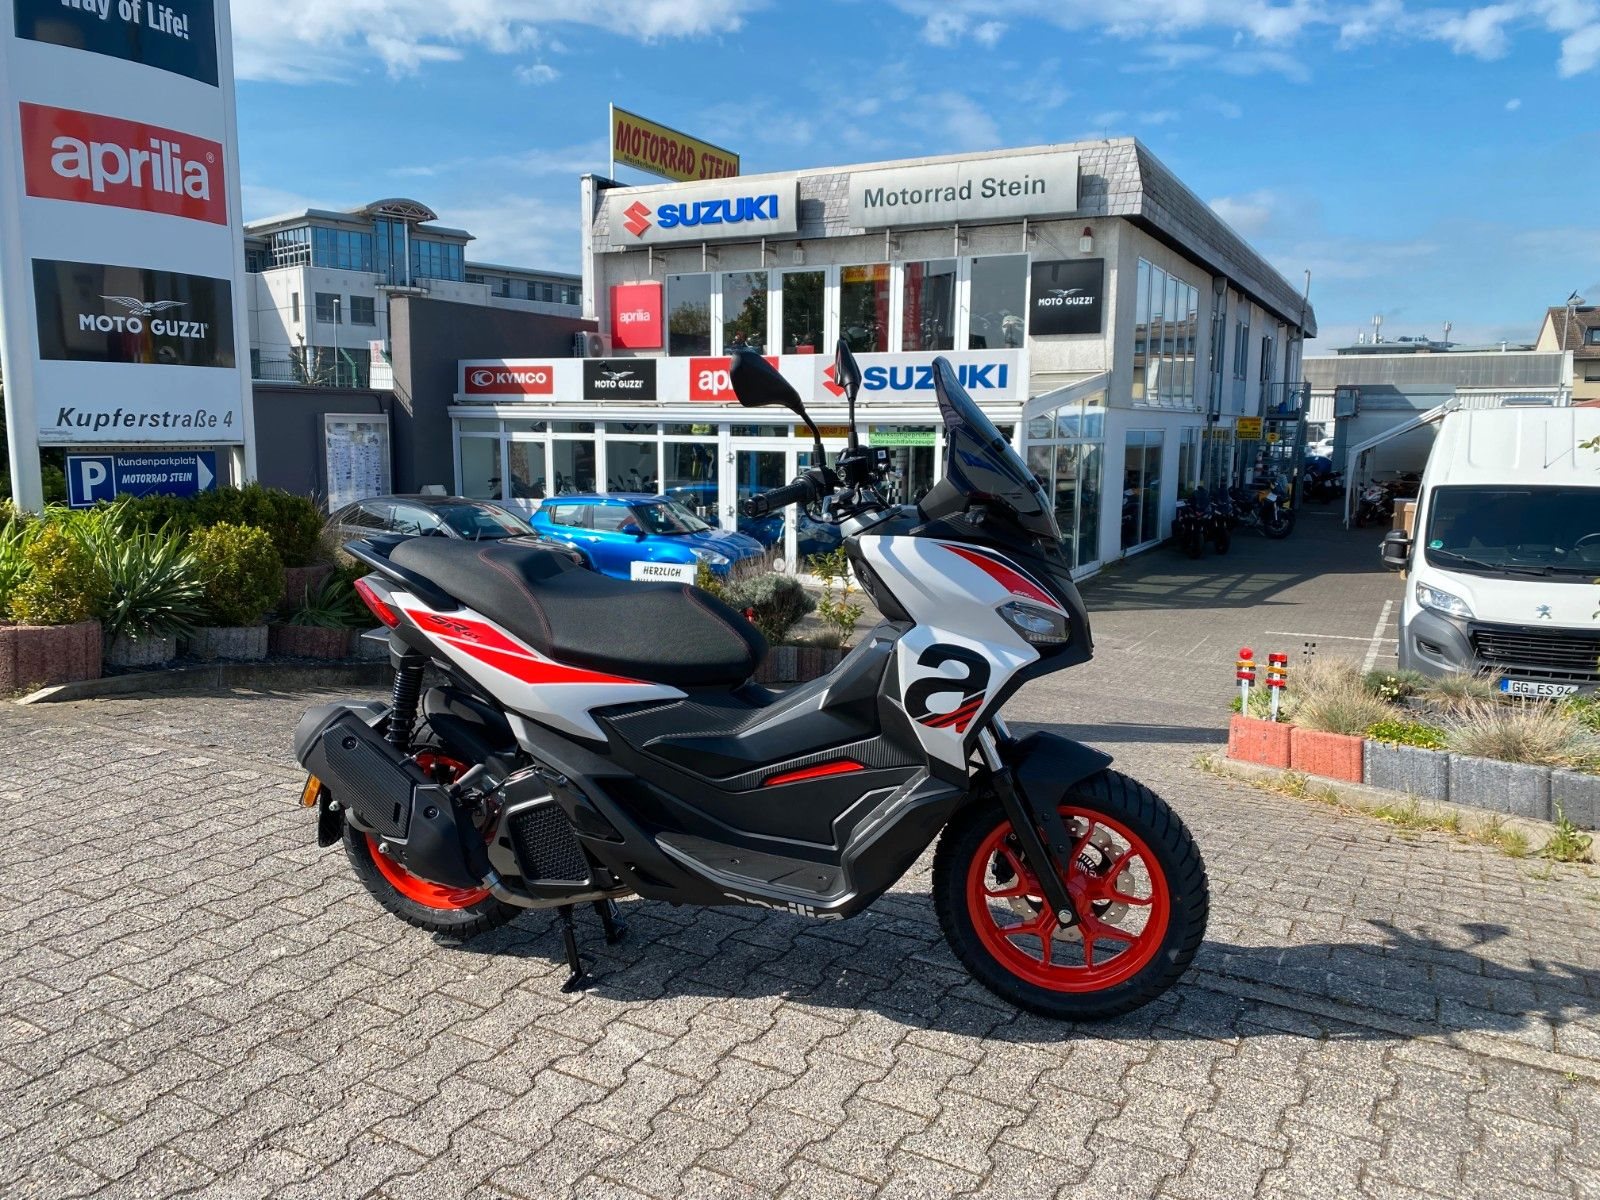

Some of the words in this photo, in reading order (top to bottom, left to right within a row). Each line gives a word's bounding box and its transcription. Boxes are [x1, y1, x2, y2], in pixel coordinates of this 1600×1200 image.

[61, 0, 110, 20] ay
[118, 0, 141, 23] of
[148, 1, 189, 40] Life!
[616, 120, 695, 175] MOTORRAD
[700, 152, 738, 179] STEIN
[51, 135, 210, 200] aprilia
[864, 180, 972, 208] Motorrad
[981, 175, 1046, 198] Stein
[657, 194, 778, 229] SUZUKI
[1038, 297, 1063, 306] MOTO
[1065, 296, 1093, 305] GUZZI
[79, 313, 142, 334] MOTO
[150, 319, 205, 339] GUZZI
[620, 308, 651, 324] aprilia
[496, 372, 546, 384] KYMCO
[595, 380, 616, 388] MOTO
[618, 380, 643, 389] GUZZI
[56, 407, 217, 432] Kupferstraße
[223, 410, 233, 427] 4
[118, 456, 196, 468] Kundenparkplatz
[81, 461, 106, 501] P
[122, 473, 167, 484] MOTORRAD
[169, 472, 192, 482] STEIN
[643, 566, 681, 577] HERZLICH
[1512, 682, 1528, 693] GG
[1537, 684, 1553, 695] ES
